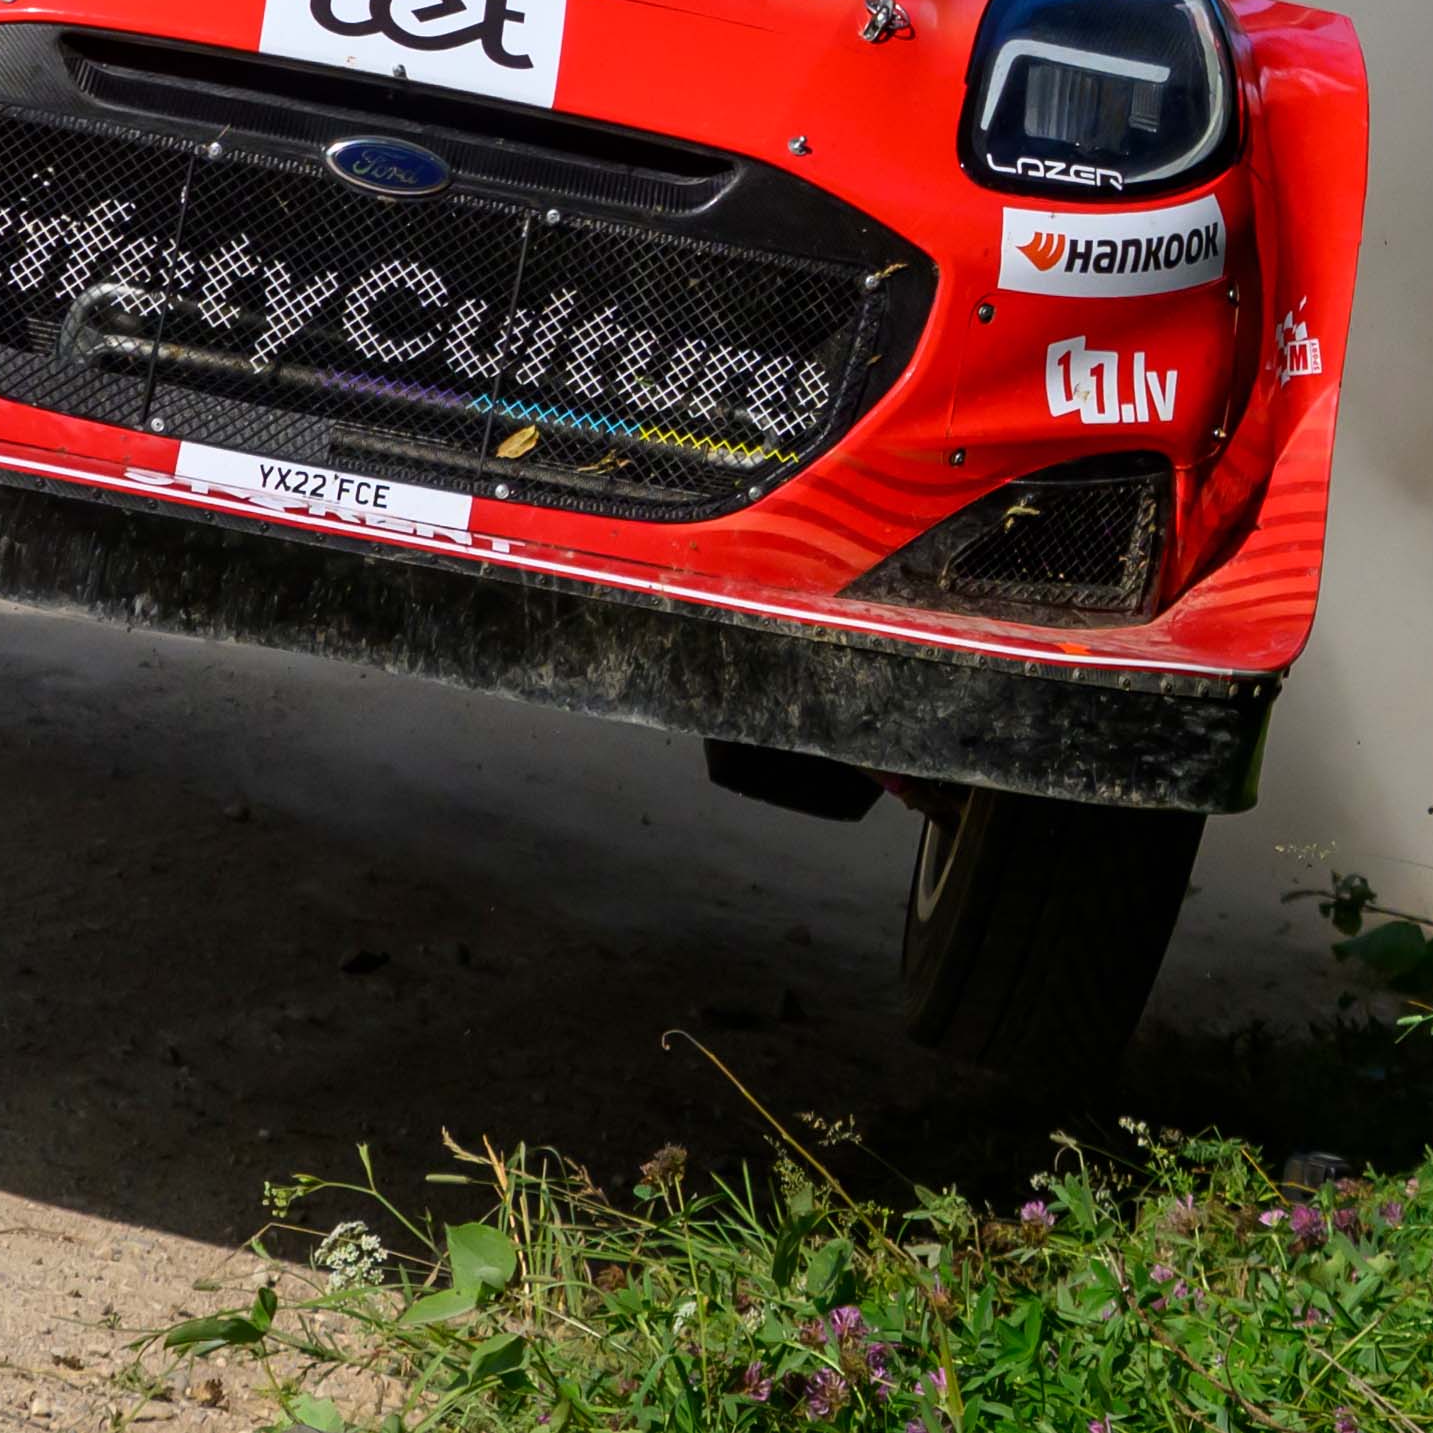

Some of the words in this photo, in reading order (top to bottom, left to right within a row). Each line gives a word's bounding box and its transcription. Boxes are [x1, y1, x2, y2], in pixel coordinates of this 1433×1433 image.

[985, 152, 1125, 192] LAZER
[1045, 335, 1179, 426] 11.lv
[259, 463, 328, 498] YX22
[335, 477, 391, 510] FCE
